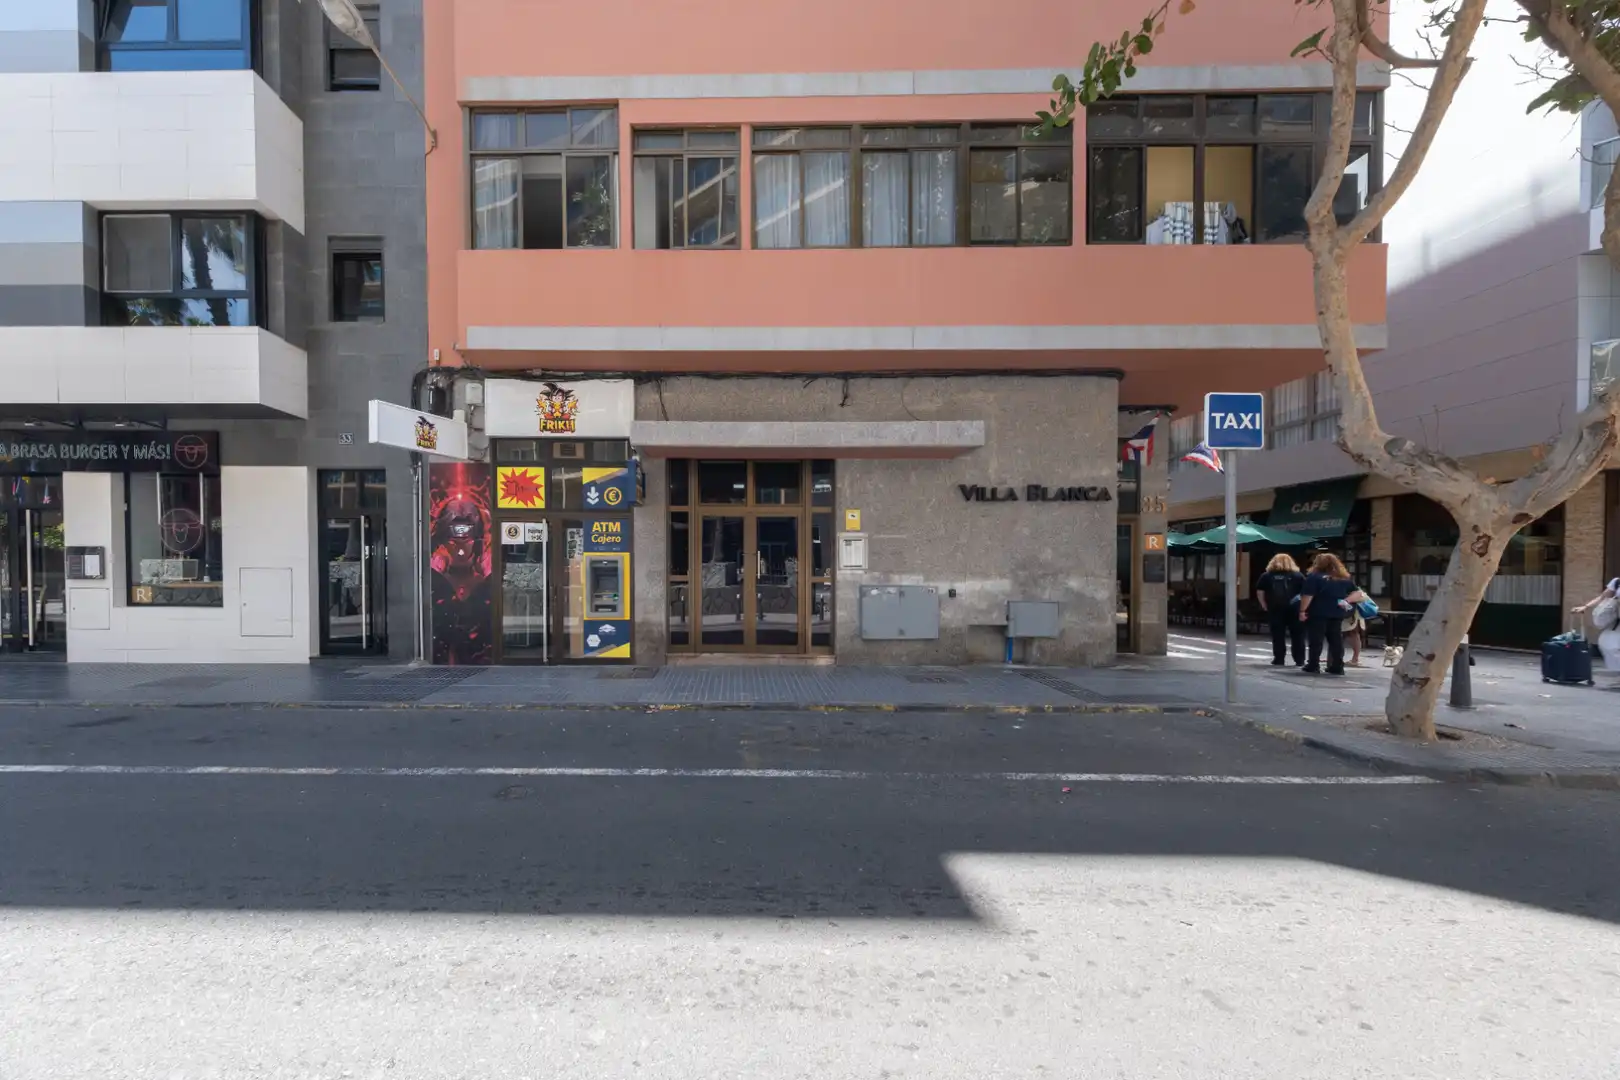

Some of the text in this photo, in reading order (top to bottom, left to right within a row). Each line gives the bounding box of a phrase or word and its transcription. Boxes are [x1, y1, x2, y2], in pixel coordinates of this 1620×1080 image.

[1211, 413, 1260, 430] TAXI
[11, 443, 57, 459] BRASA
[60, 443, 117, 459] BURGER
[119, 444, 130, 459] Y
[133, 440, 171, 459] MÁS!
[958, 484, 1112, 502] VILLA BLANCA
[592, 522, 621, 532] ATM
[592, 534, 621, 545] Cajero
[1149, 536, 1159, 549] R
[137, 588, 147, 601] R
